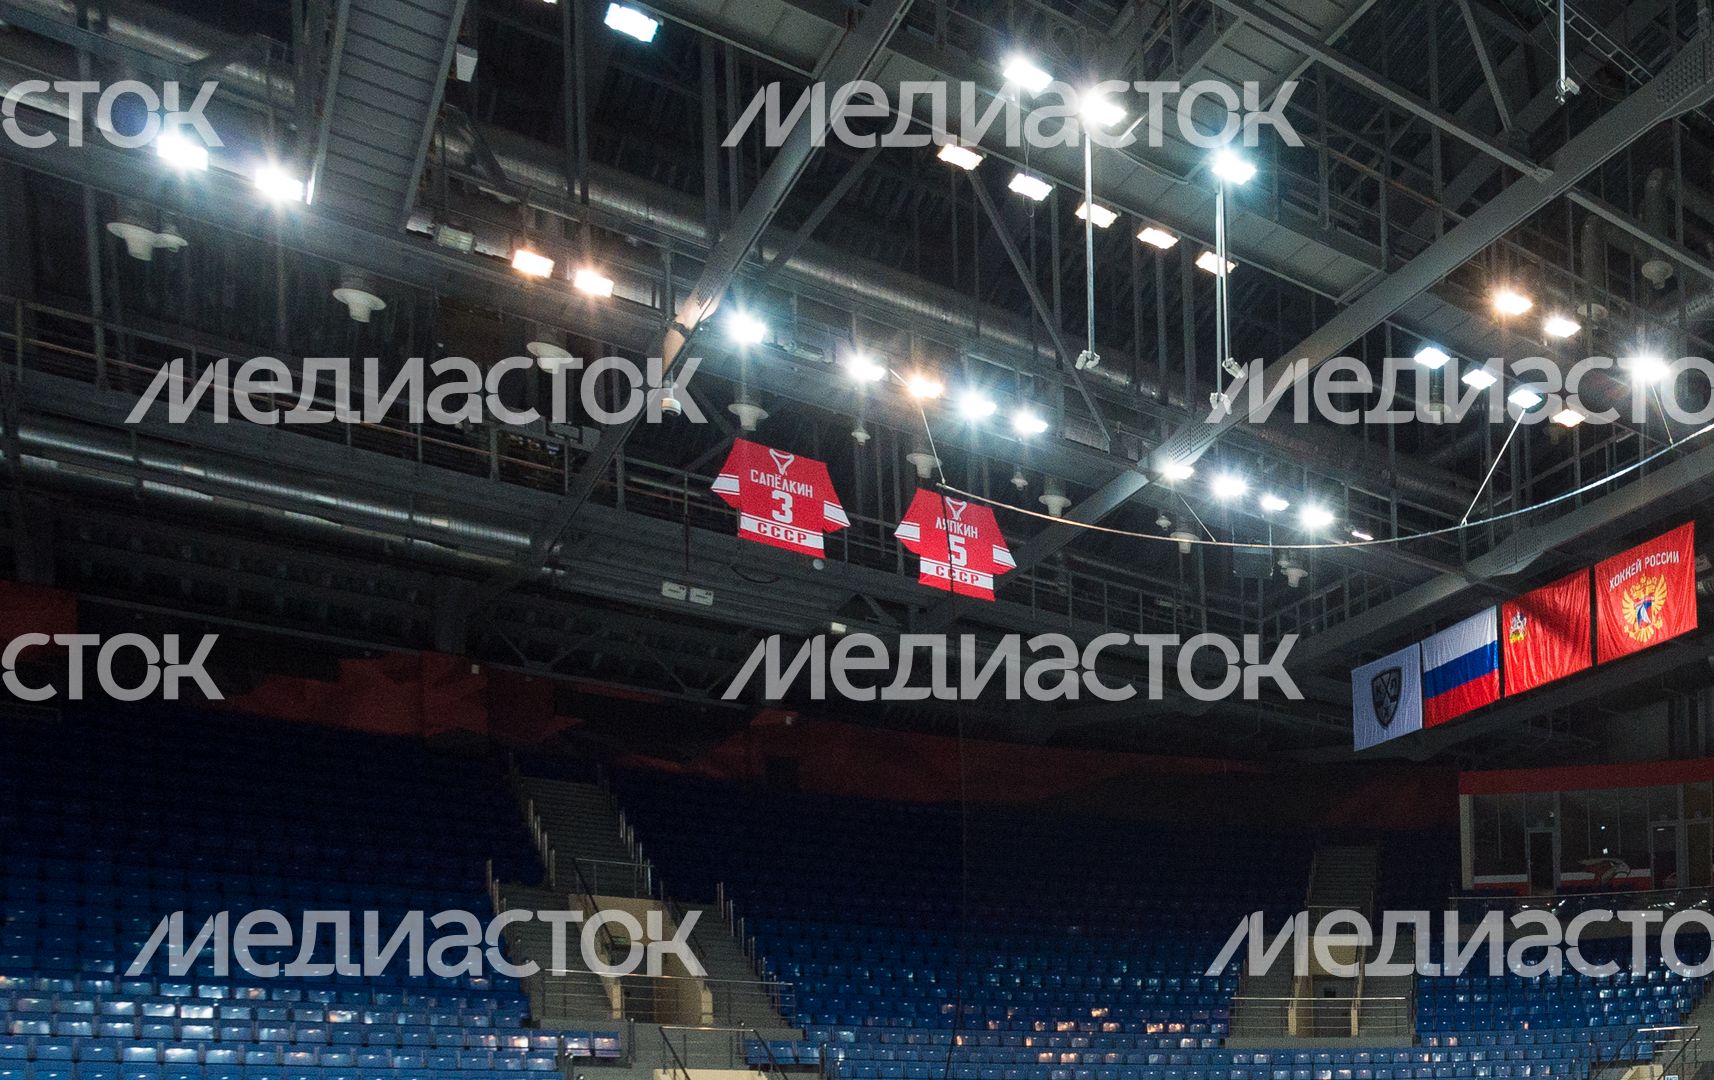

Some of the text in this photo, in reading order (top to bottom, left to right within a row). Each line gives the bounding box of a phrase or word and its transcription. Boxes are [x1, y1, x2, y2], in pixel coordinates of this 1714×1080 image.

[750, 469, 813, 498] САПЁЛКИН
[772, 490, 793, 524] 3
[757, 521, 808, 544] СССР
[935, 516, 979, 539] ЛЯПКИН
[949, 535, 967, 566] 5
[935, 564, 980, 585] СССР
[1609, 550, 1680, 591] ХОККЕЙ РОССИИ
